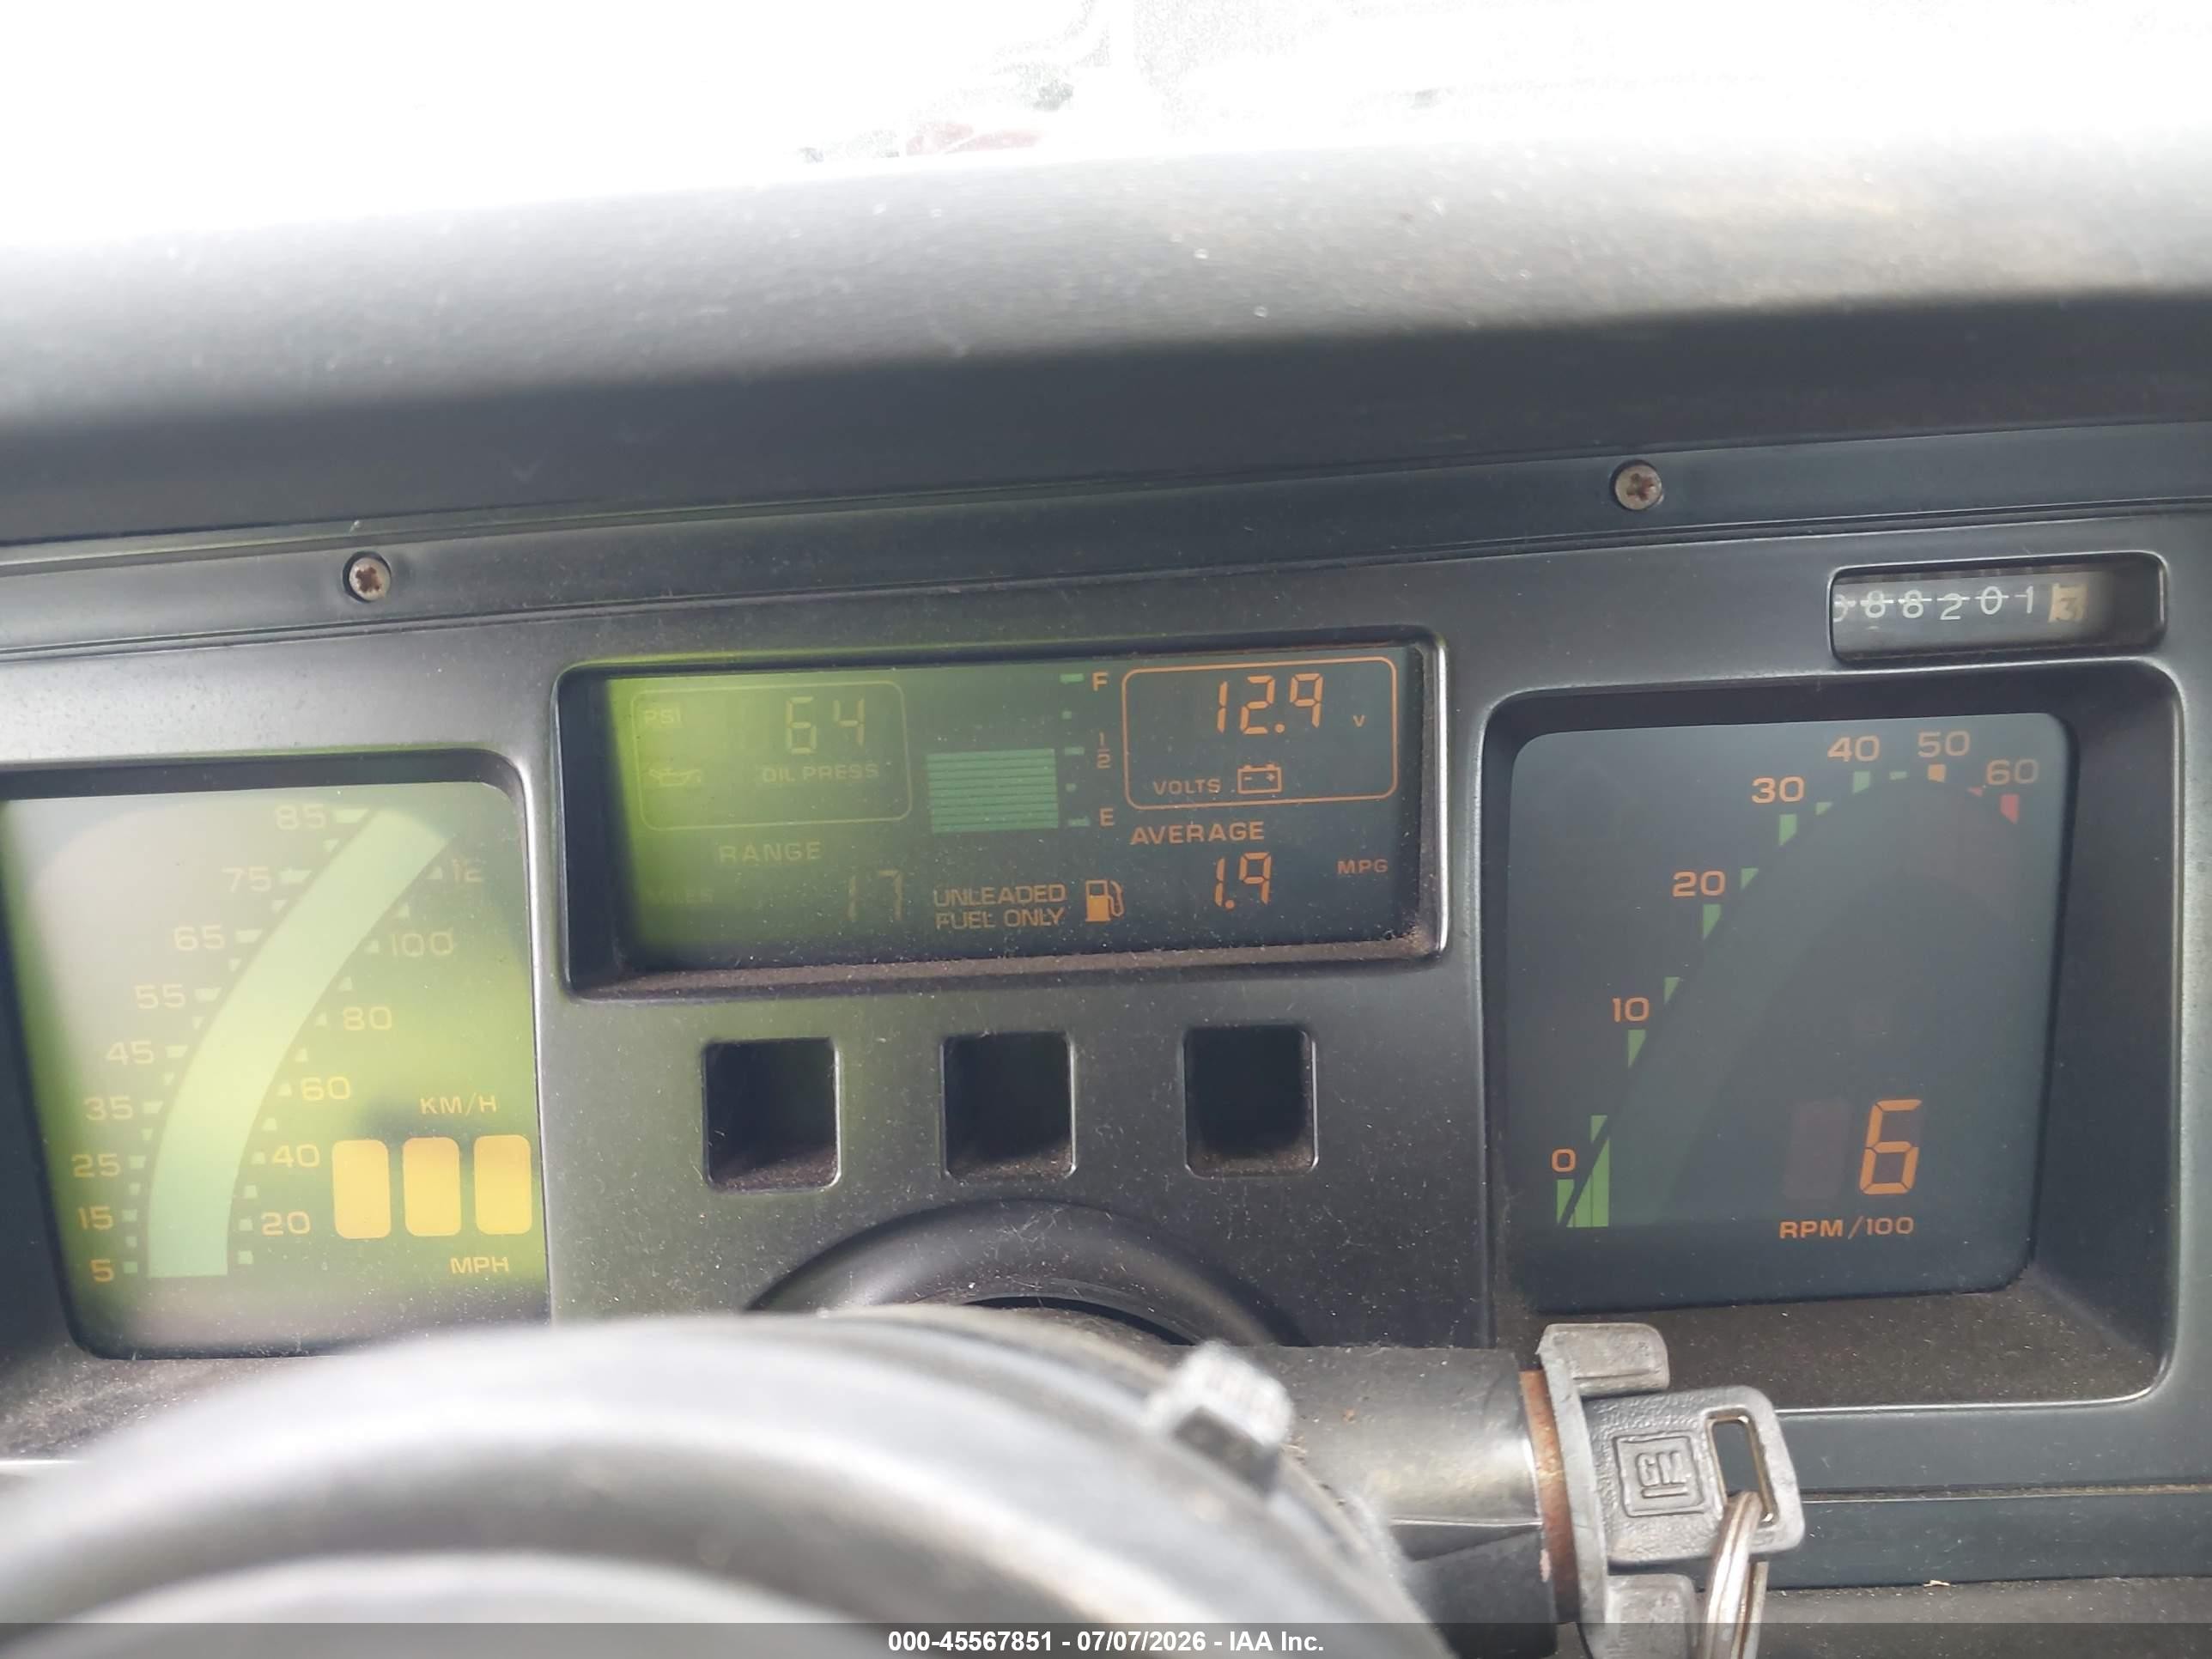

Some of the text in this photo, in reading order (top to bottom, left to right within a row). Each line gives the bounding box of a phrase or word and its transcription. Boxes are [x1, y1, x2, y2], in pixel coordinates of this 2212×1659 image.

[1092, 672, 1109, 691] F
[1216, 673, 1323, 735] 12.9
[644, 708, 681, 726] PSI
[785, 696, 865, 755] 64
[1827, 736, 1881, 763] 40
[1917, 731, 1971, 757] 50
[762, 763, 878, 783] OIL PRESS
[1985, 758, 2039, 785] 60
[1153, 778, 1221, 795] VOLTS
[1752, 776, 1804, 803] 30
[276, 804, 326, 829] 85
[1100, 808, 1115, 826] E
[1130, 822, 1264, 844] AVERAGE
[719, 842, 822, 864] RANGE
[1338, 859, 1389, 874] MPG
[223, 868, 272, 892] 75
[1215, 852, 1272, 909] 1.9
[1672, 871, 1726, 897] 20
[847, 870, 902, 922] 17
[934, 883, 1066, 908] UNLEADED
[935, 906, 1066, 929] FUEL ONLY
[173, 926, 224, 951] 65
[390, 931, 454, 955] 100
[136, 985, 185, 1008] 55
[342, 1006, 392, 1031] 80
[1612, 997, 1650, 1023] 10
[106, 1041, 154, 1064] 45
[301, 1077, 351, 1102] 60
[85, 1097, 133, 1120] 35
[420, 1095, 497, 1115] KM/H
[271, 1145, 319, 1168] 40
[1858, 1099, 1922, 1194] 6
[71, 1153, 120, 1177] 25
[1551, 1148, 1576, 1172] 0
[79, 1206, 112, 1230] 15
[261, 1212, 310, 1235] 20
[92, 1259, 114, 1282] 5
[451, 1255, 509, 1273] MPH
[1636, 1450, 1688, 1486] GM
